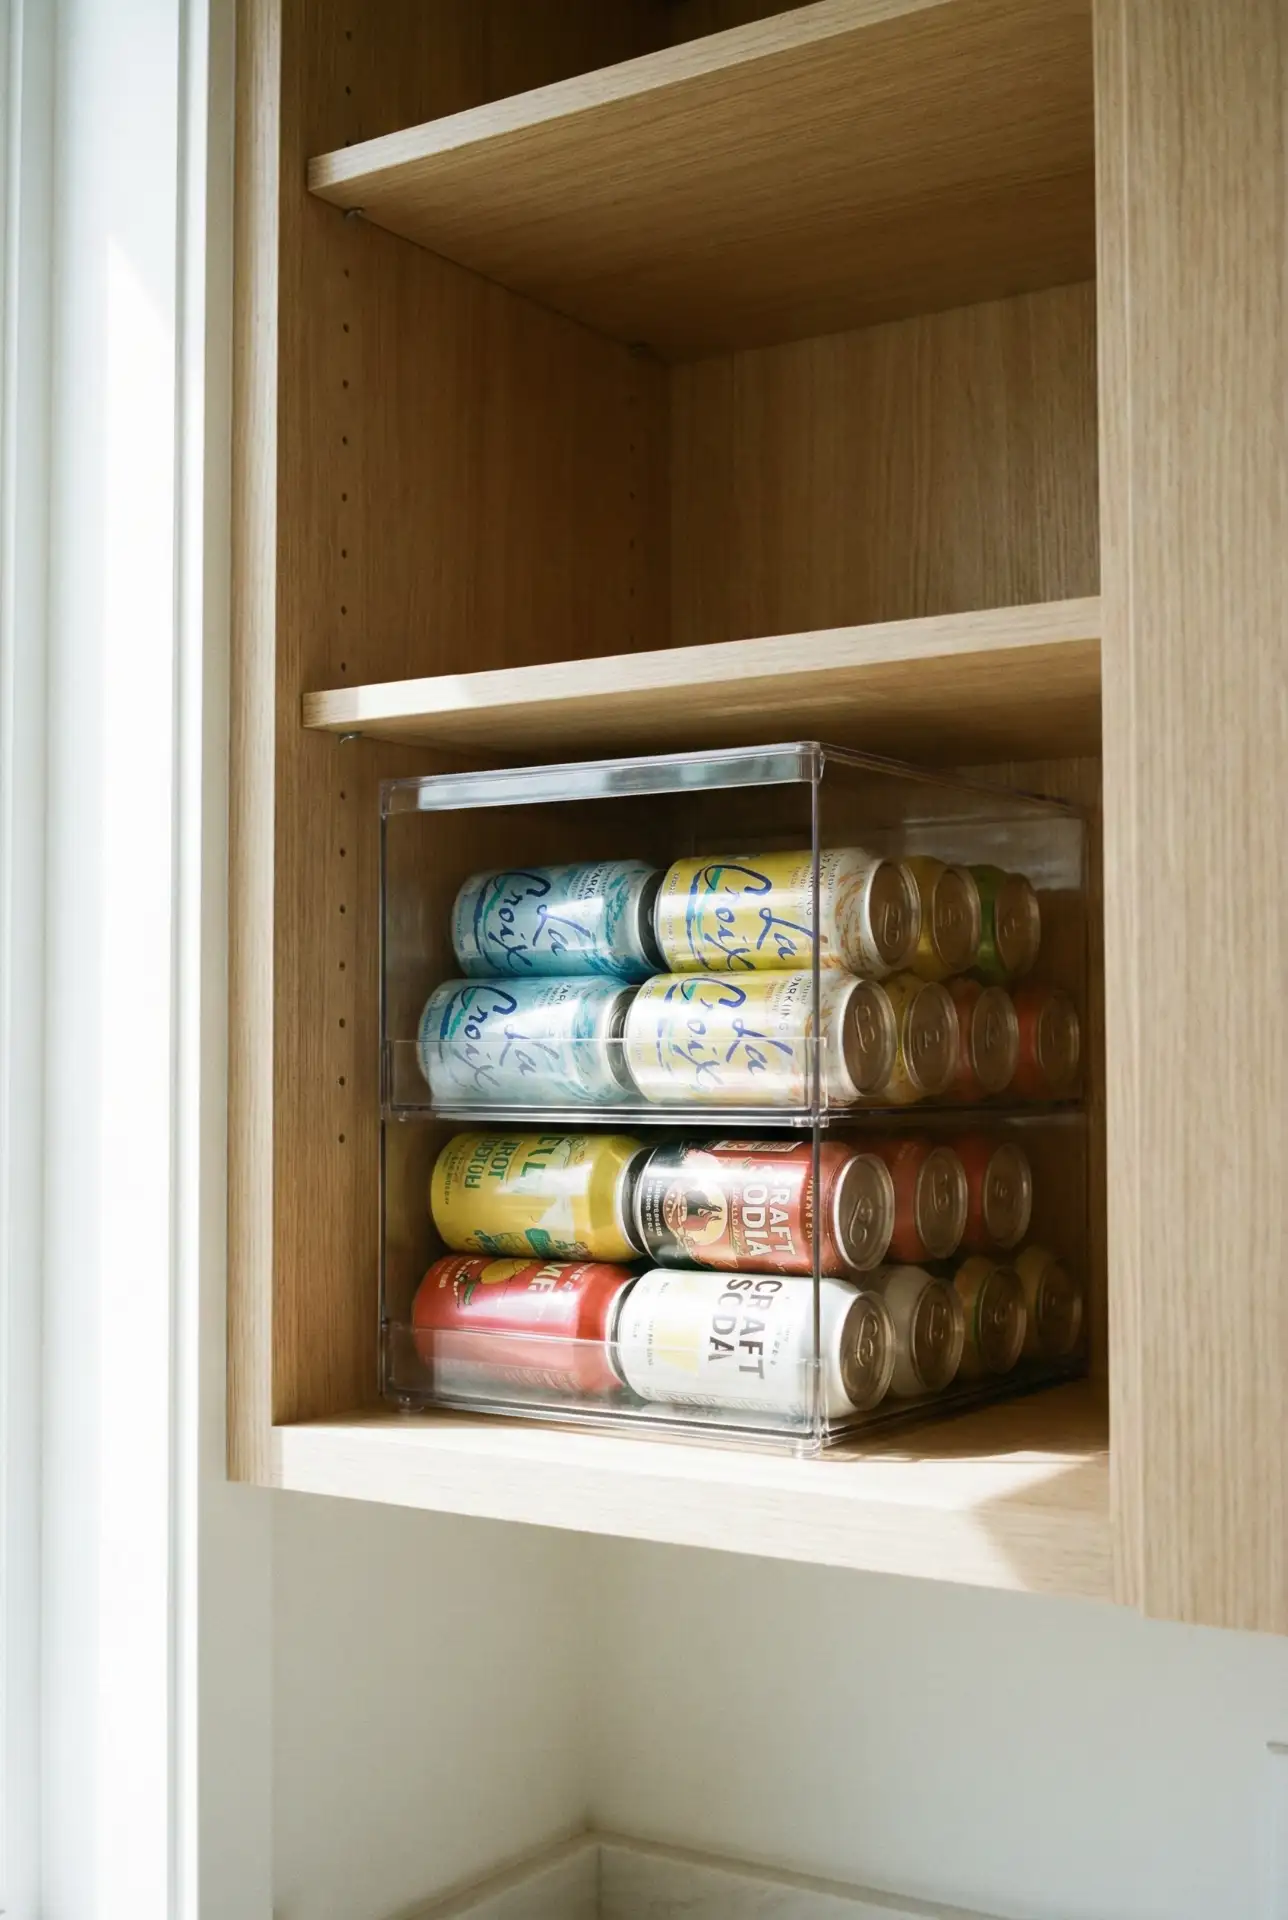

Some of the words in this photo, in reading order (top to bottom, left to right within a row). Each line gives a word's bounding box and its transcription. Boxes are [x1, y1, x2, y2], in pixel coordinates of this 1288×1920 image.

[488, 872, 552, 976] Croix
[533, 905, 591, 957] La
[704, 865, 772, 971] Croix
[757, 908, 828, 960] La
[453, 987, 518, 1091] Croix
[500, 1025, 559, 1075] La
[673, 978, 747, 1087] Croix
[726, 1019, 793, 1076] La
[741, 1168, 773, 1256] ODIA
[769, 1174, 797, 1255] RAFT
[708, 1279, 753, 1361] SODA
[739, 1280, 783, 1379] CRAFT
